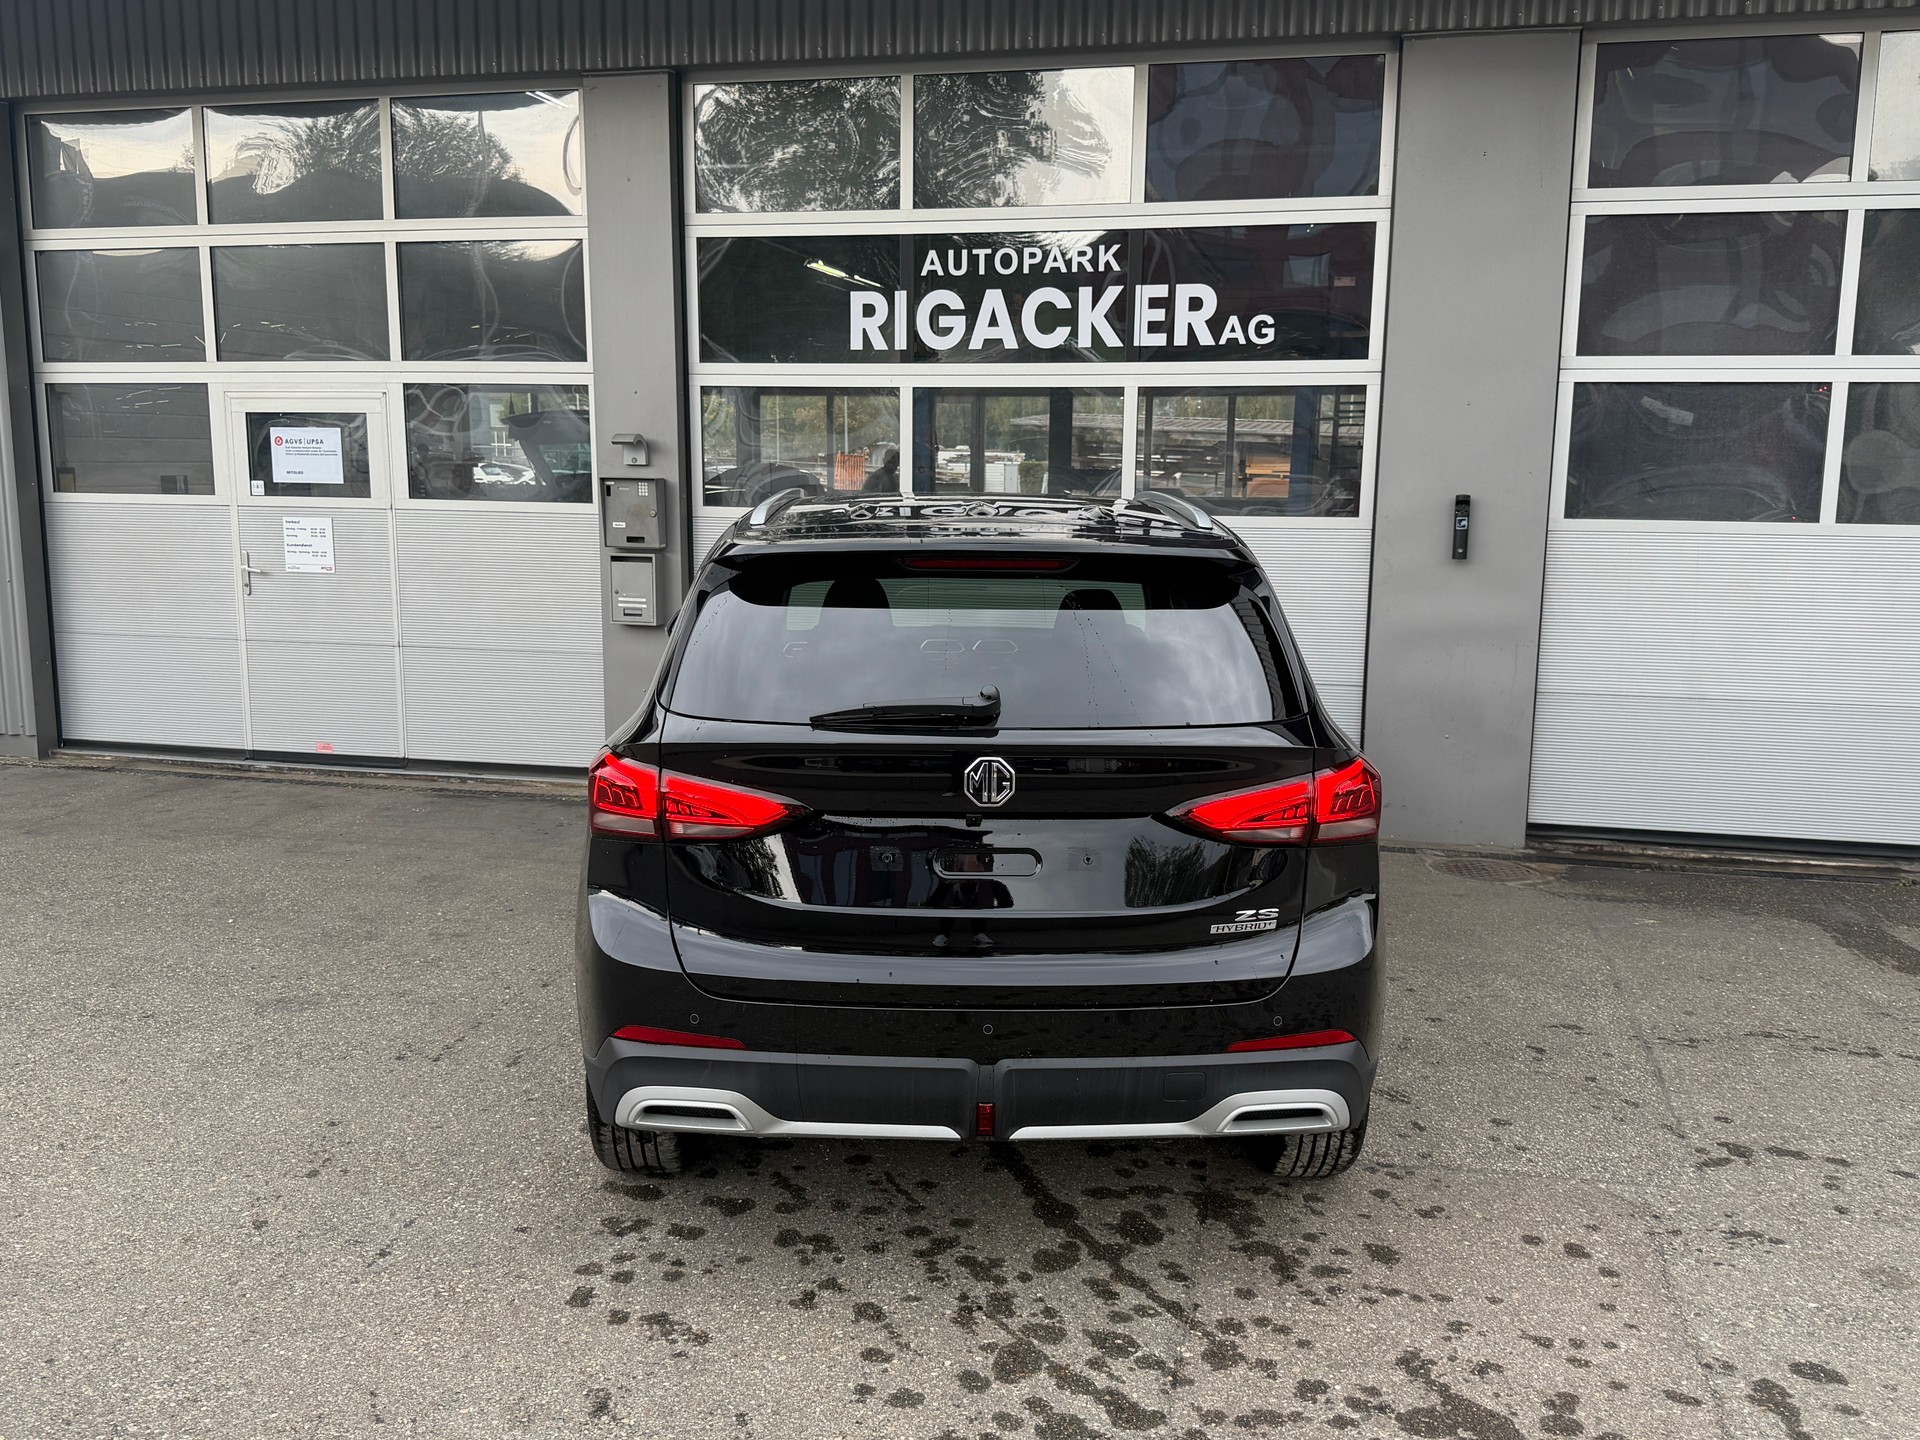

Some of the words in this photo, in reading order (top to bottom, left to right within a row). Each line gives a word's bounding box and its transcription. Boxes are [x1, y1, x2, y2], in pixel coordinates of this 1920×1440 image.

[920, 244, 1122, 276] AUTOPARK
[849, 283, 1218, 351] RIGACKER
[1218, 314, 1276, 346] AG
[969, 761, 1011, 803] MG
[1234, 908, 1280, 922] ZS
